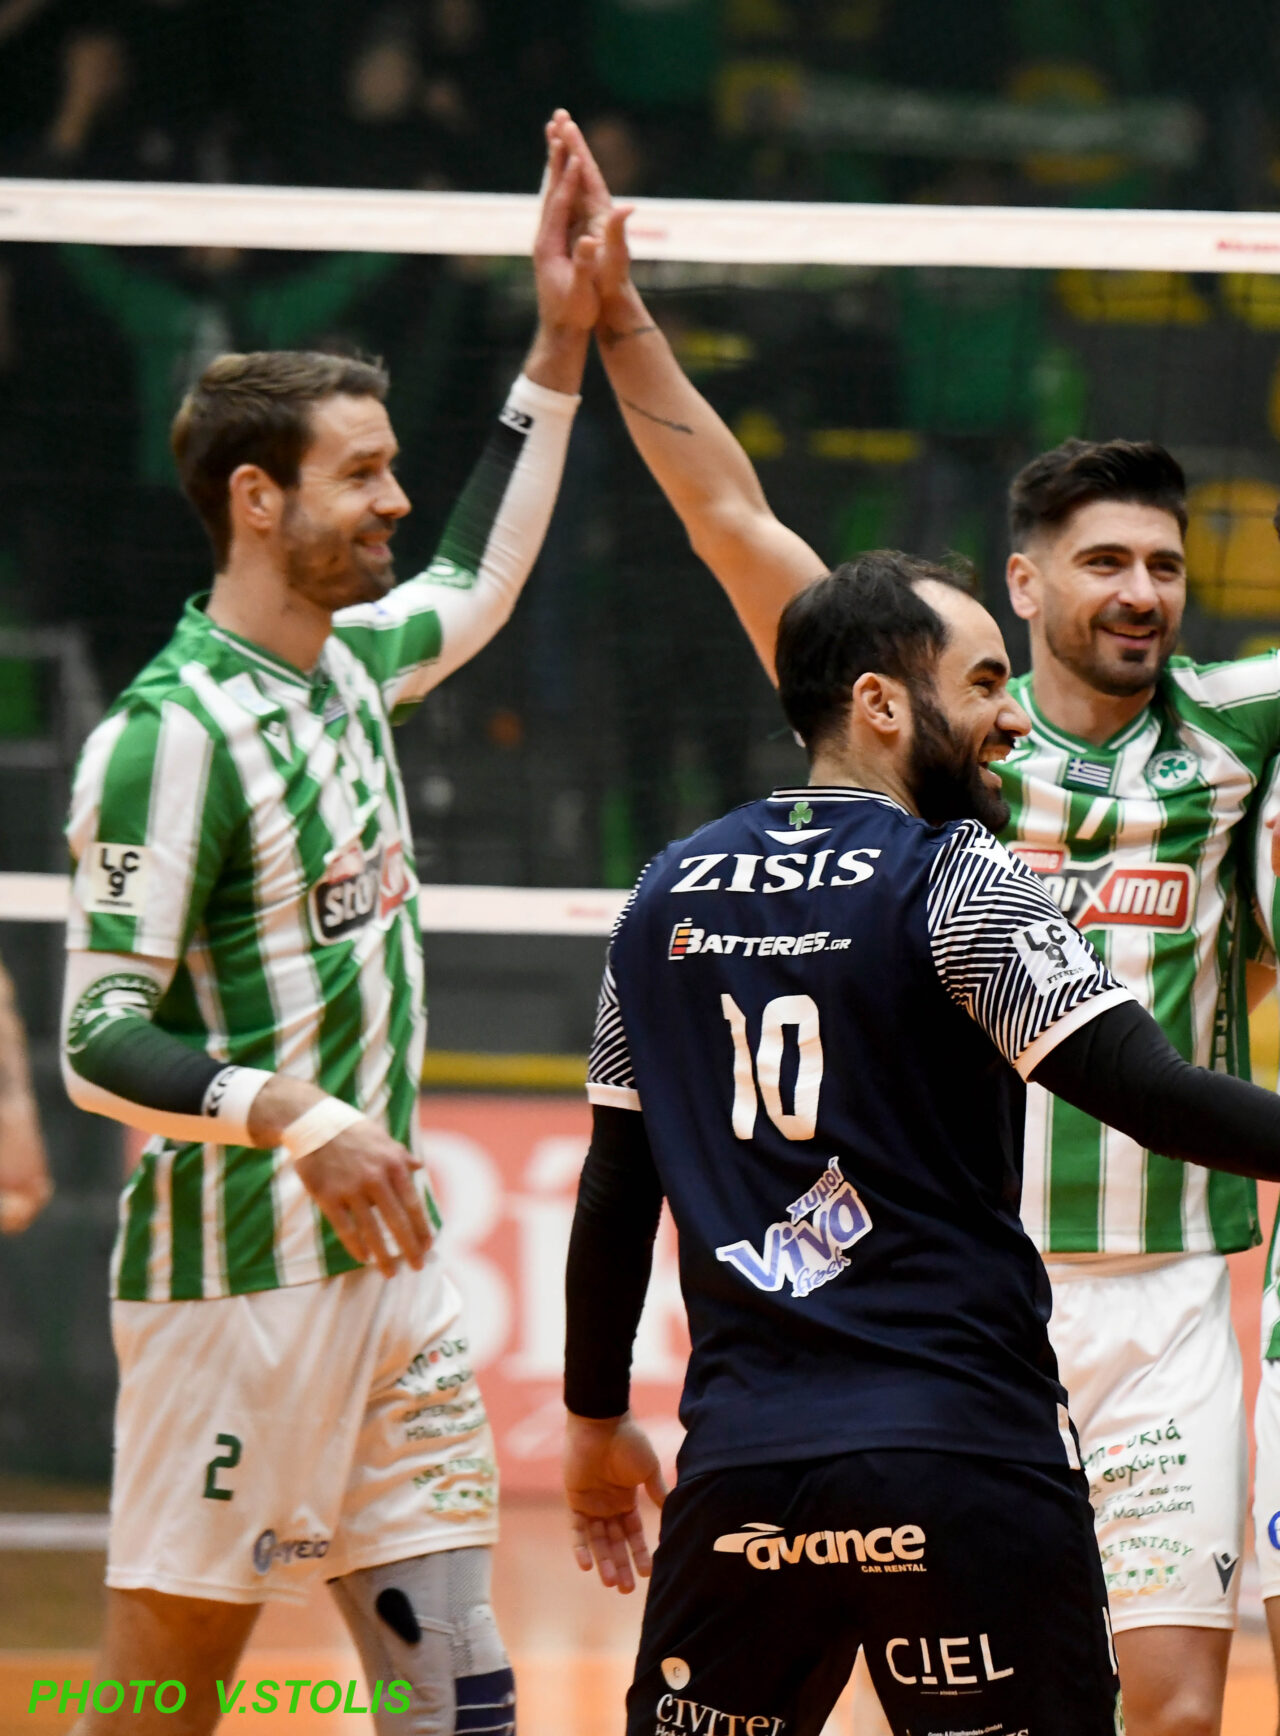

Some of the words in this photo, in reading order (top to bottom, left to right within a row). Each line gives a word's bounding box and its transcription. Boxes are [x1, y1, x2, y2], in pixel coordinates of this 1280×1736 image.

[670, 848, 881, 894] ZISIS
[720, 993, 824, 1141] 10
[203, 1433, 241, 1501] 2
[744, 1524, 927, 1571] avance
[861, 1565, 883, 1574] CAR
[885, 1564, 928, 1573] RENTAL
[885, 1633, 1015, 1685] CIEL
